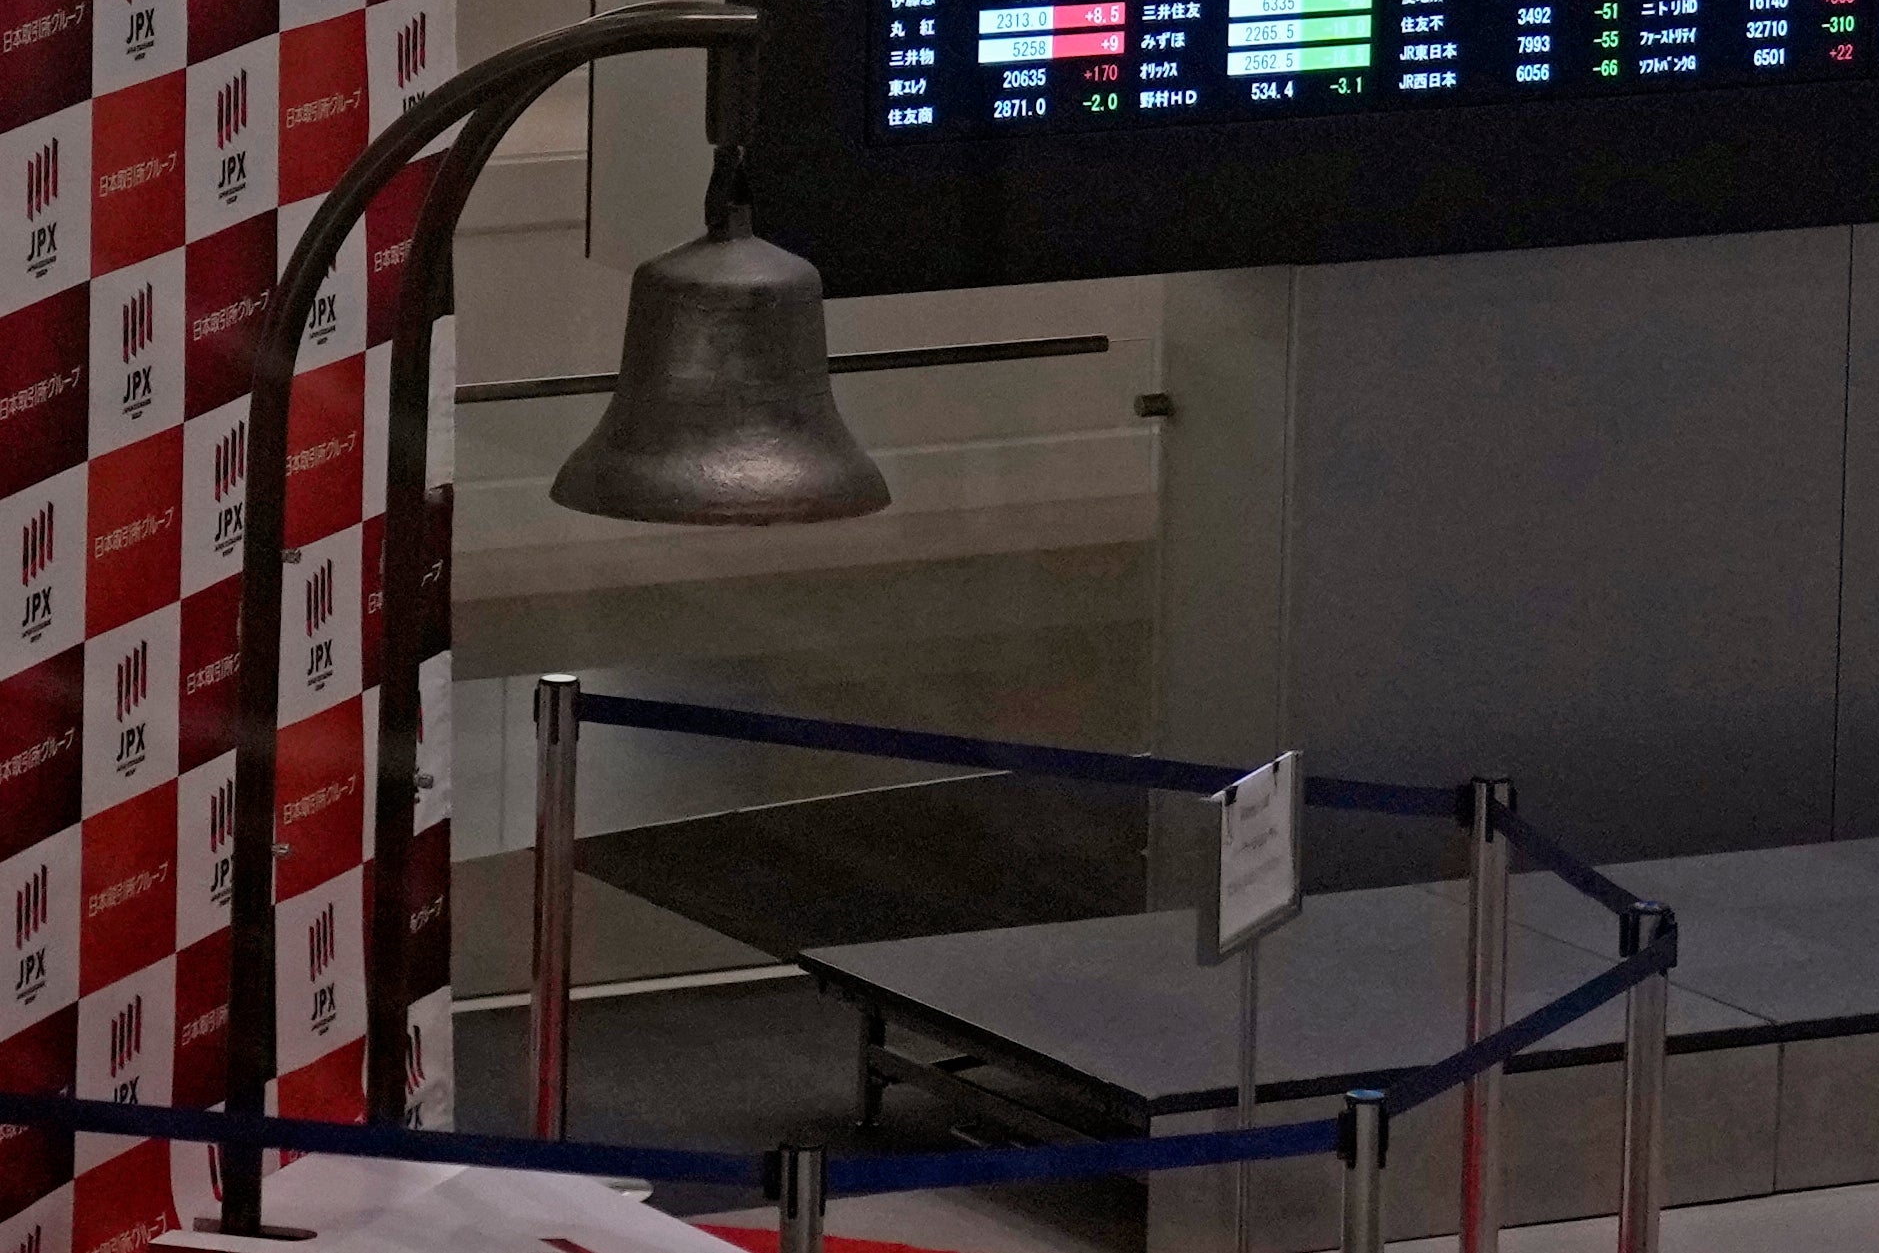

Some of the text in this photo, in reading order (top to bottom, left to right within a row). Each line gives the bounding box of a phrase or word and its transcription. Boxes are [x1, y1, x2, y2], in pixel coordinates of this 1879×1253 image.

[126, 8, 155, 43] JPX
[1746, 20, 1788, 38] 32710
[1003, 68, 1046, 88] 20635
[218, 152, 246, 187] JPX
[27, 223, 57, 261] JPX
[123, 366, 152, 403] JPX
[215, 503, 243, 541] JPX
[22, 587, 52, 627] JPX
[307, 640, 332, 675] JPX
[117, 724, 145, 761] JPX
[16, 949, 46, 990] JPX
[312, 983, 336, 1021] JPX
